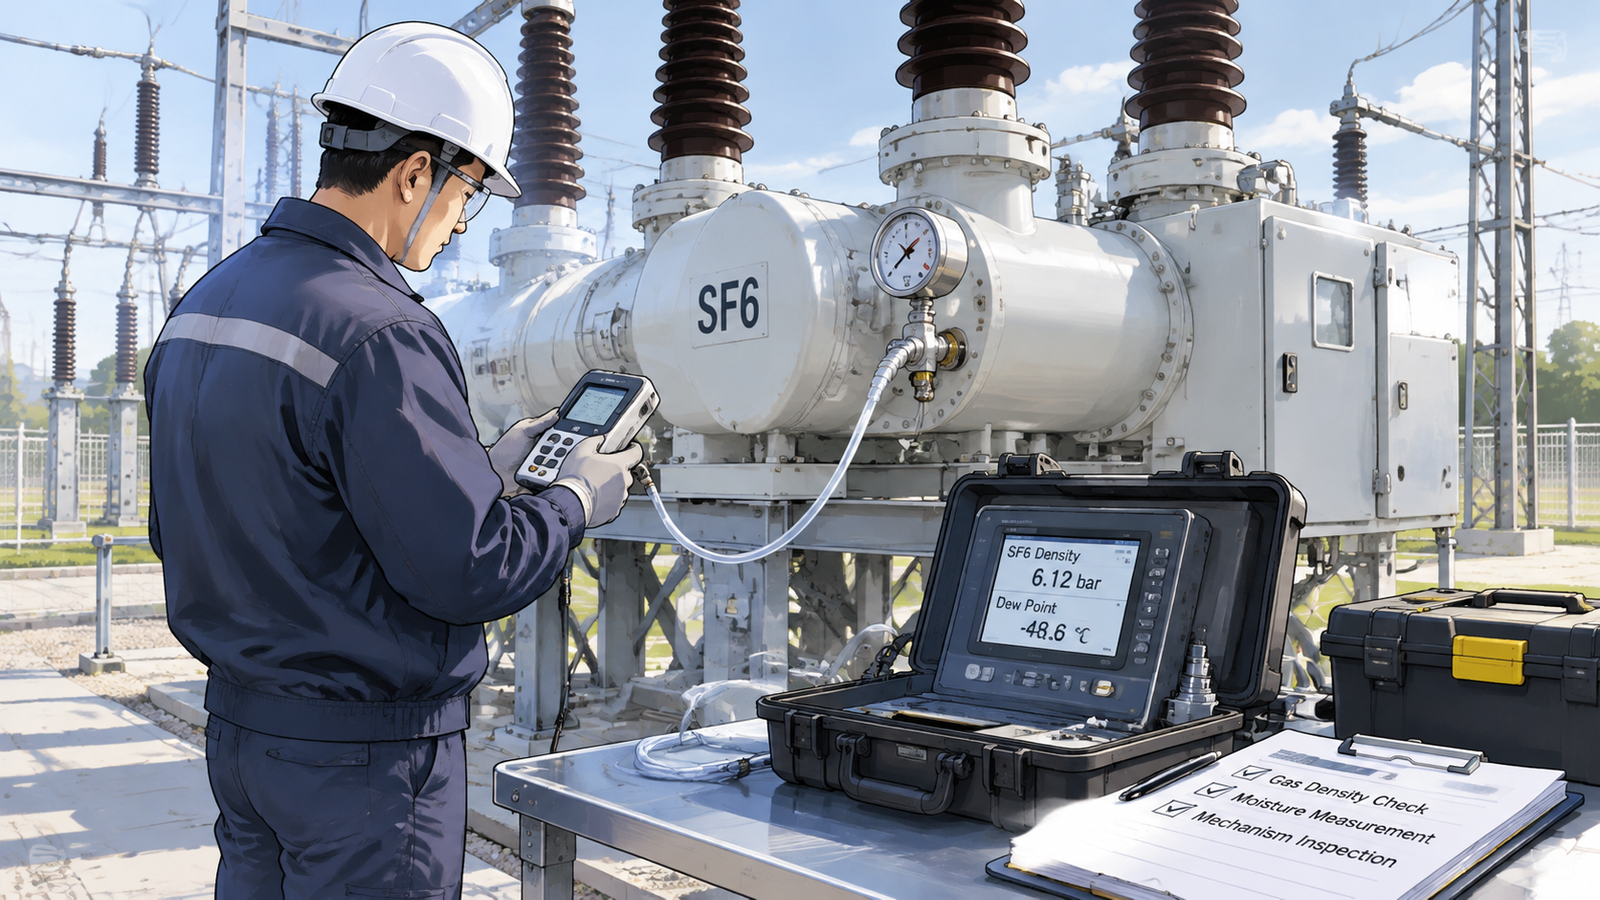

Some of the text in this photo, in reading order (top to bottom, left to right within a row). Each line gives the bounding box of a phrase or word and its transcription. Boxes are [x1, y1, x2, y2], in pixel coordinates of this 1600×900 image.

[698, 276, 759, 334] SF6
[1007, 545, 1081, 564] SF6 Density
[1031, 568, 1102, 591] 6.12 bar
[996, 597, 1057, 615] Dew Point
[1020, 620, 1067, 642] -48.6
[1269, 774, 1430, 816] Gas Density Check
[1231, 792, 1436, 845] Moisture Measurement
[1191, 811, 1398, 868] Mechanism Inspection
